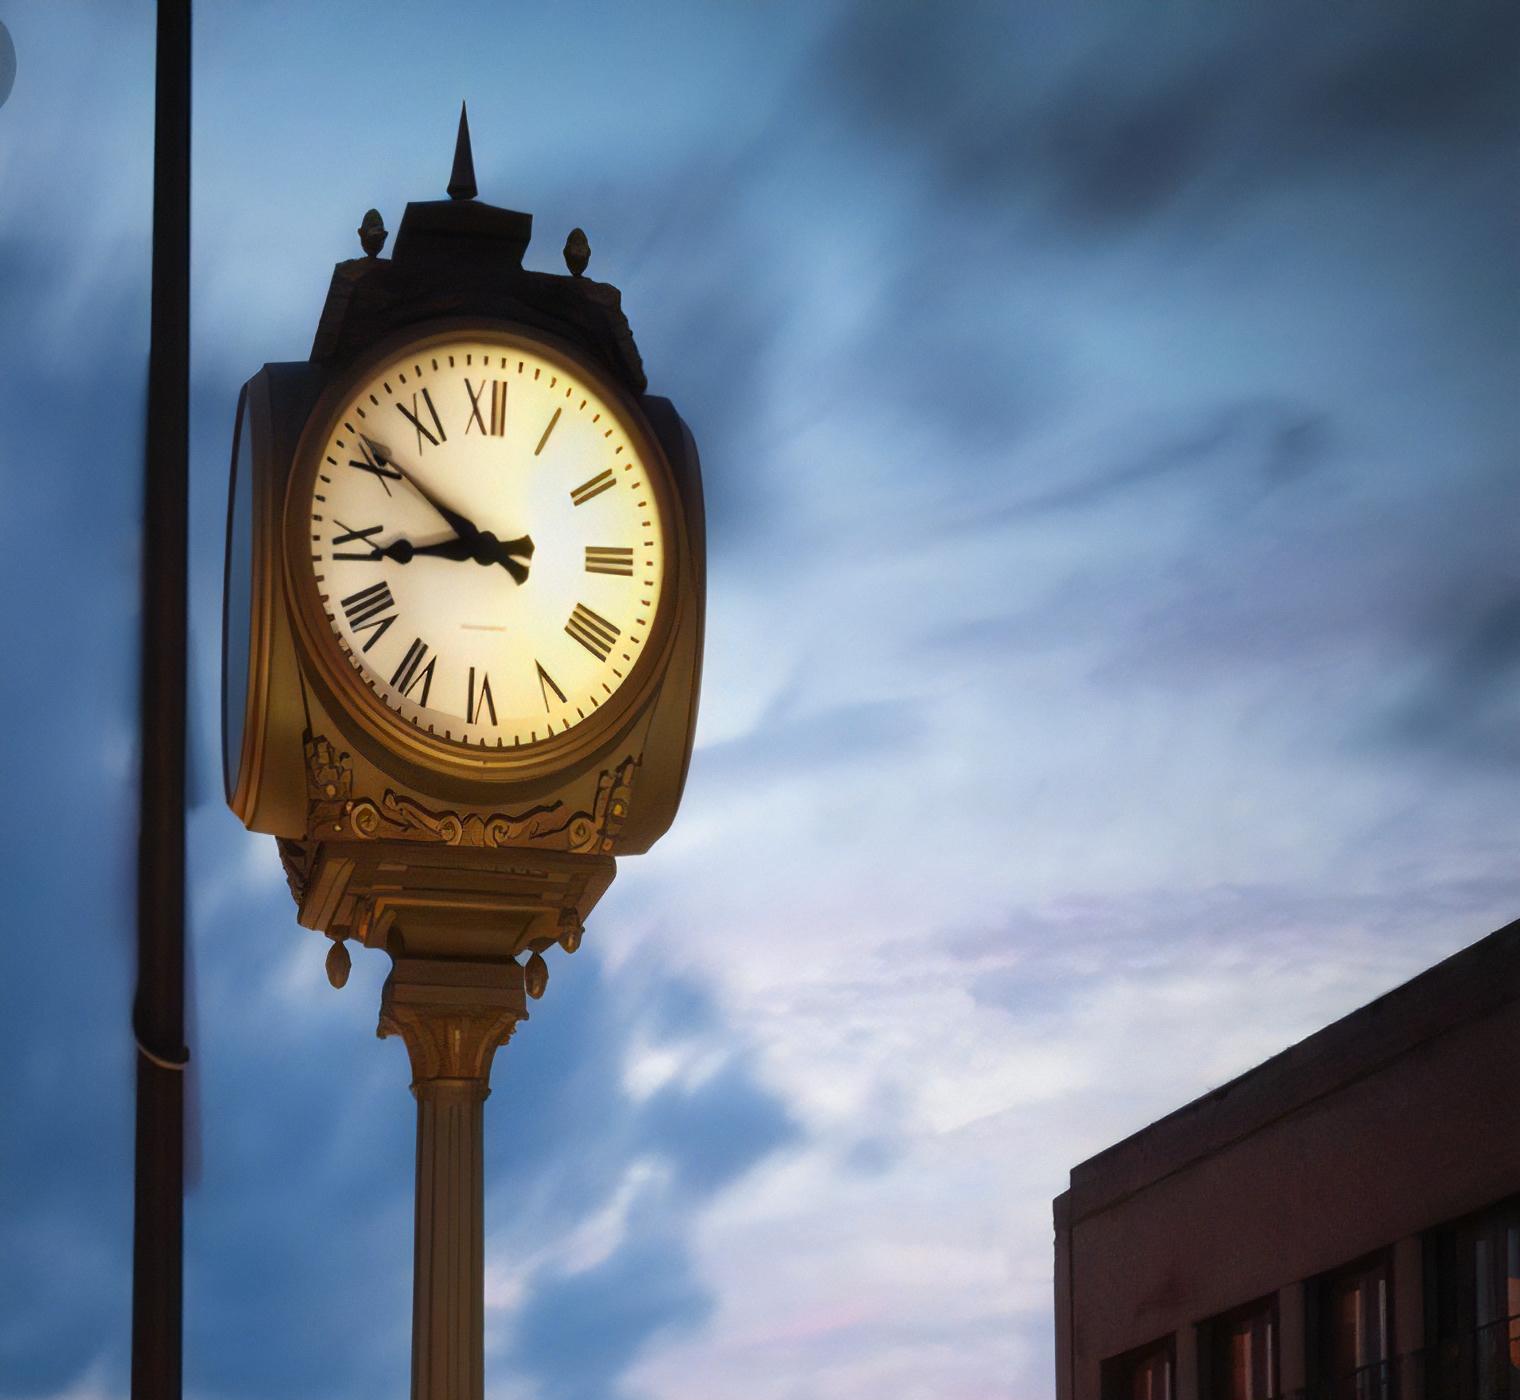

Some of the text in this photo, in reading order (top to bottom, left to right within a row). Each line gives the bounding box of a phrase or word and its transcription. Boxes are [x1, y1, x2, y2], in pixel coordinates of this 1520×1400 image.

[396, 387, 447, 457] XI
[464, 377, 508, 437] XII
[569, 467, 617, 507] II
[585, 545, 634, 577] III
[465, 666, 498, 727] VI
